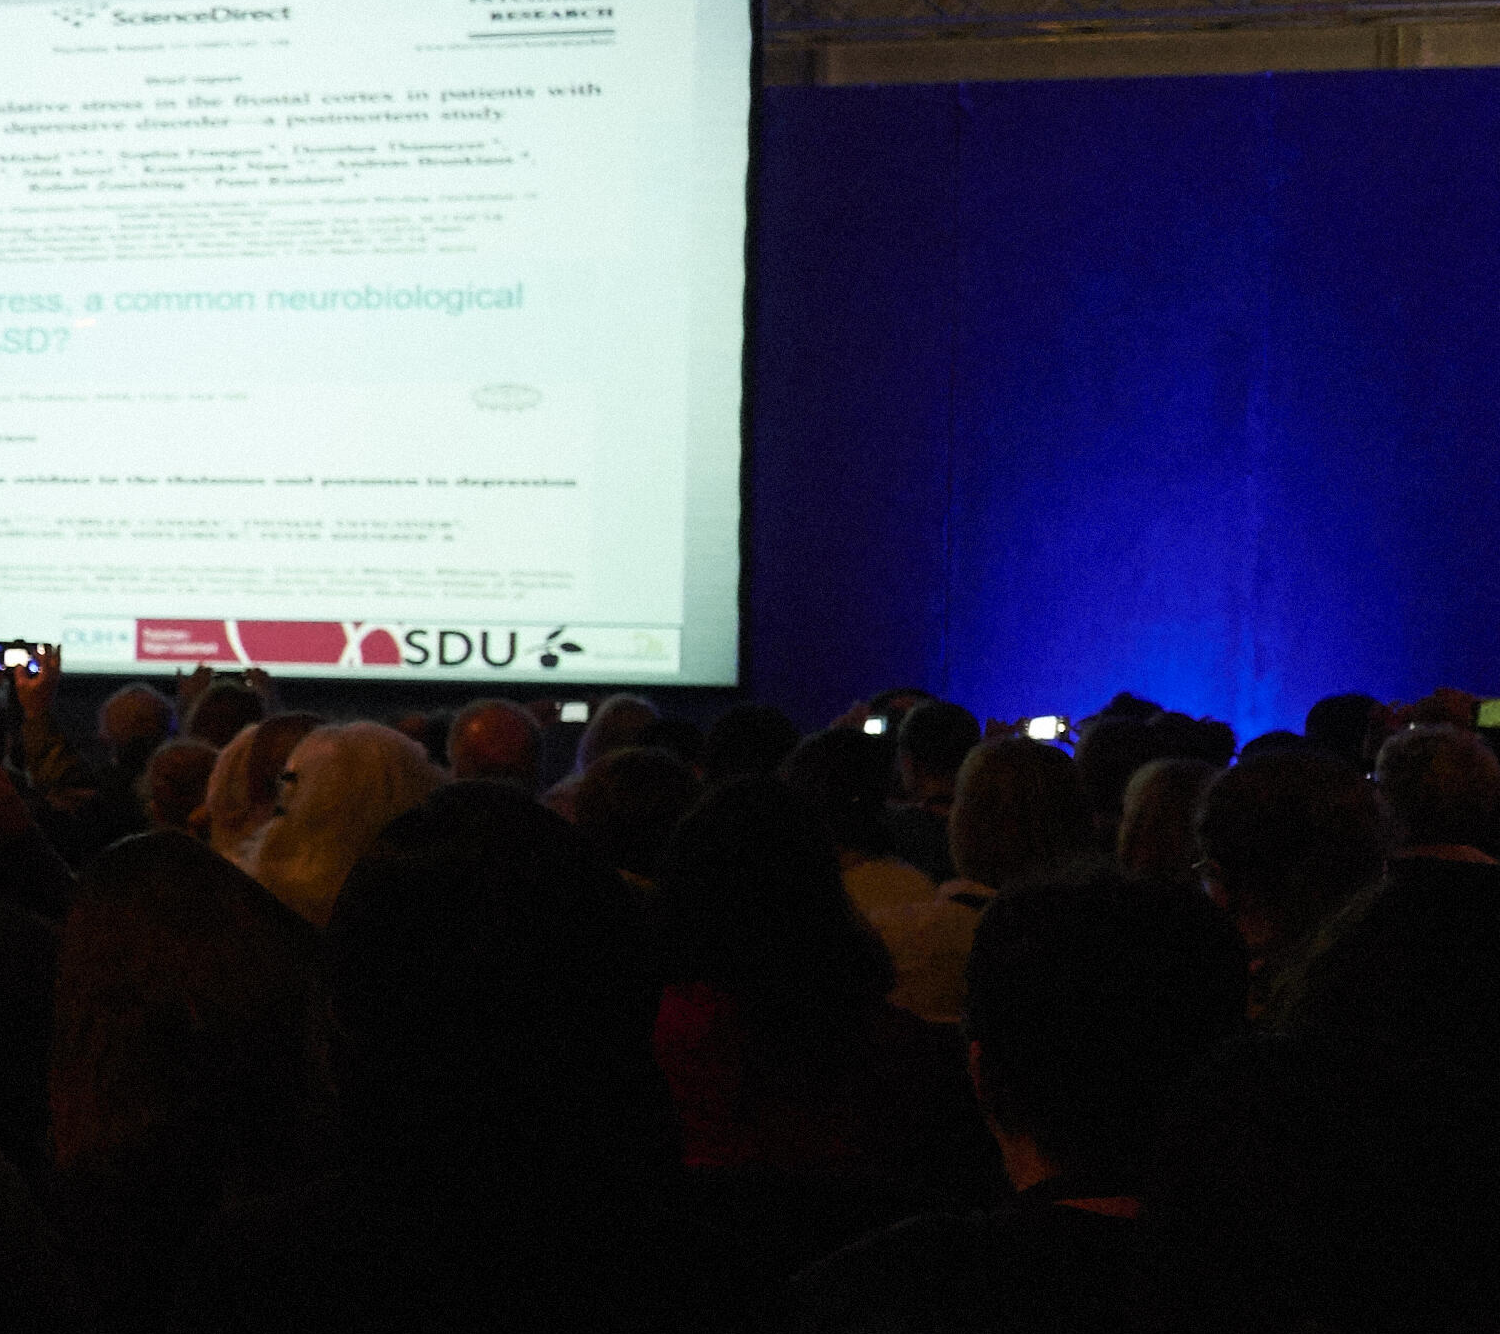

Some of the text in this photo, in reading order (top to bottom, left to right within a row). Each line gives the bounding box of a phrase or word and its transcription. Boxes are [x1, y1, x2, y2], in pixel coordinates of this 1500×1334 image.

[112, 5, 291, 27] ScienceDirect
[83, 294, 104, 313] a
[114, 289, 255, 312] common
[266, 280, 524, 317] neurobiological
[403, 629, 517, 667] SDU
